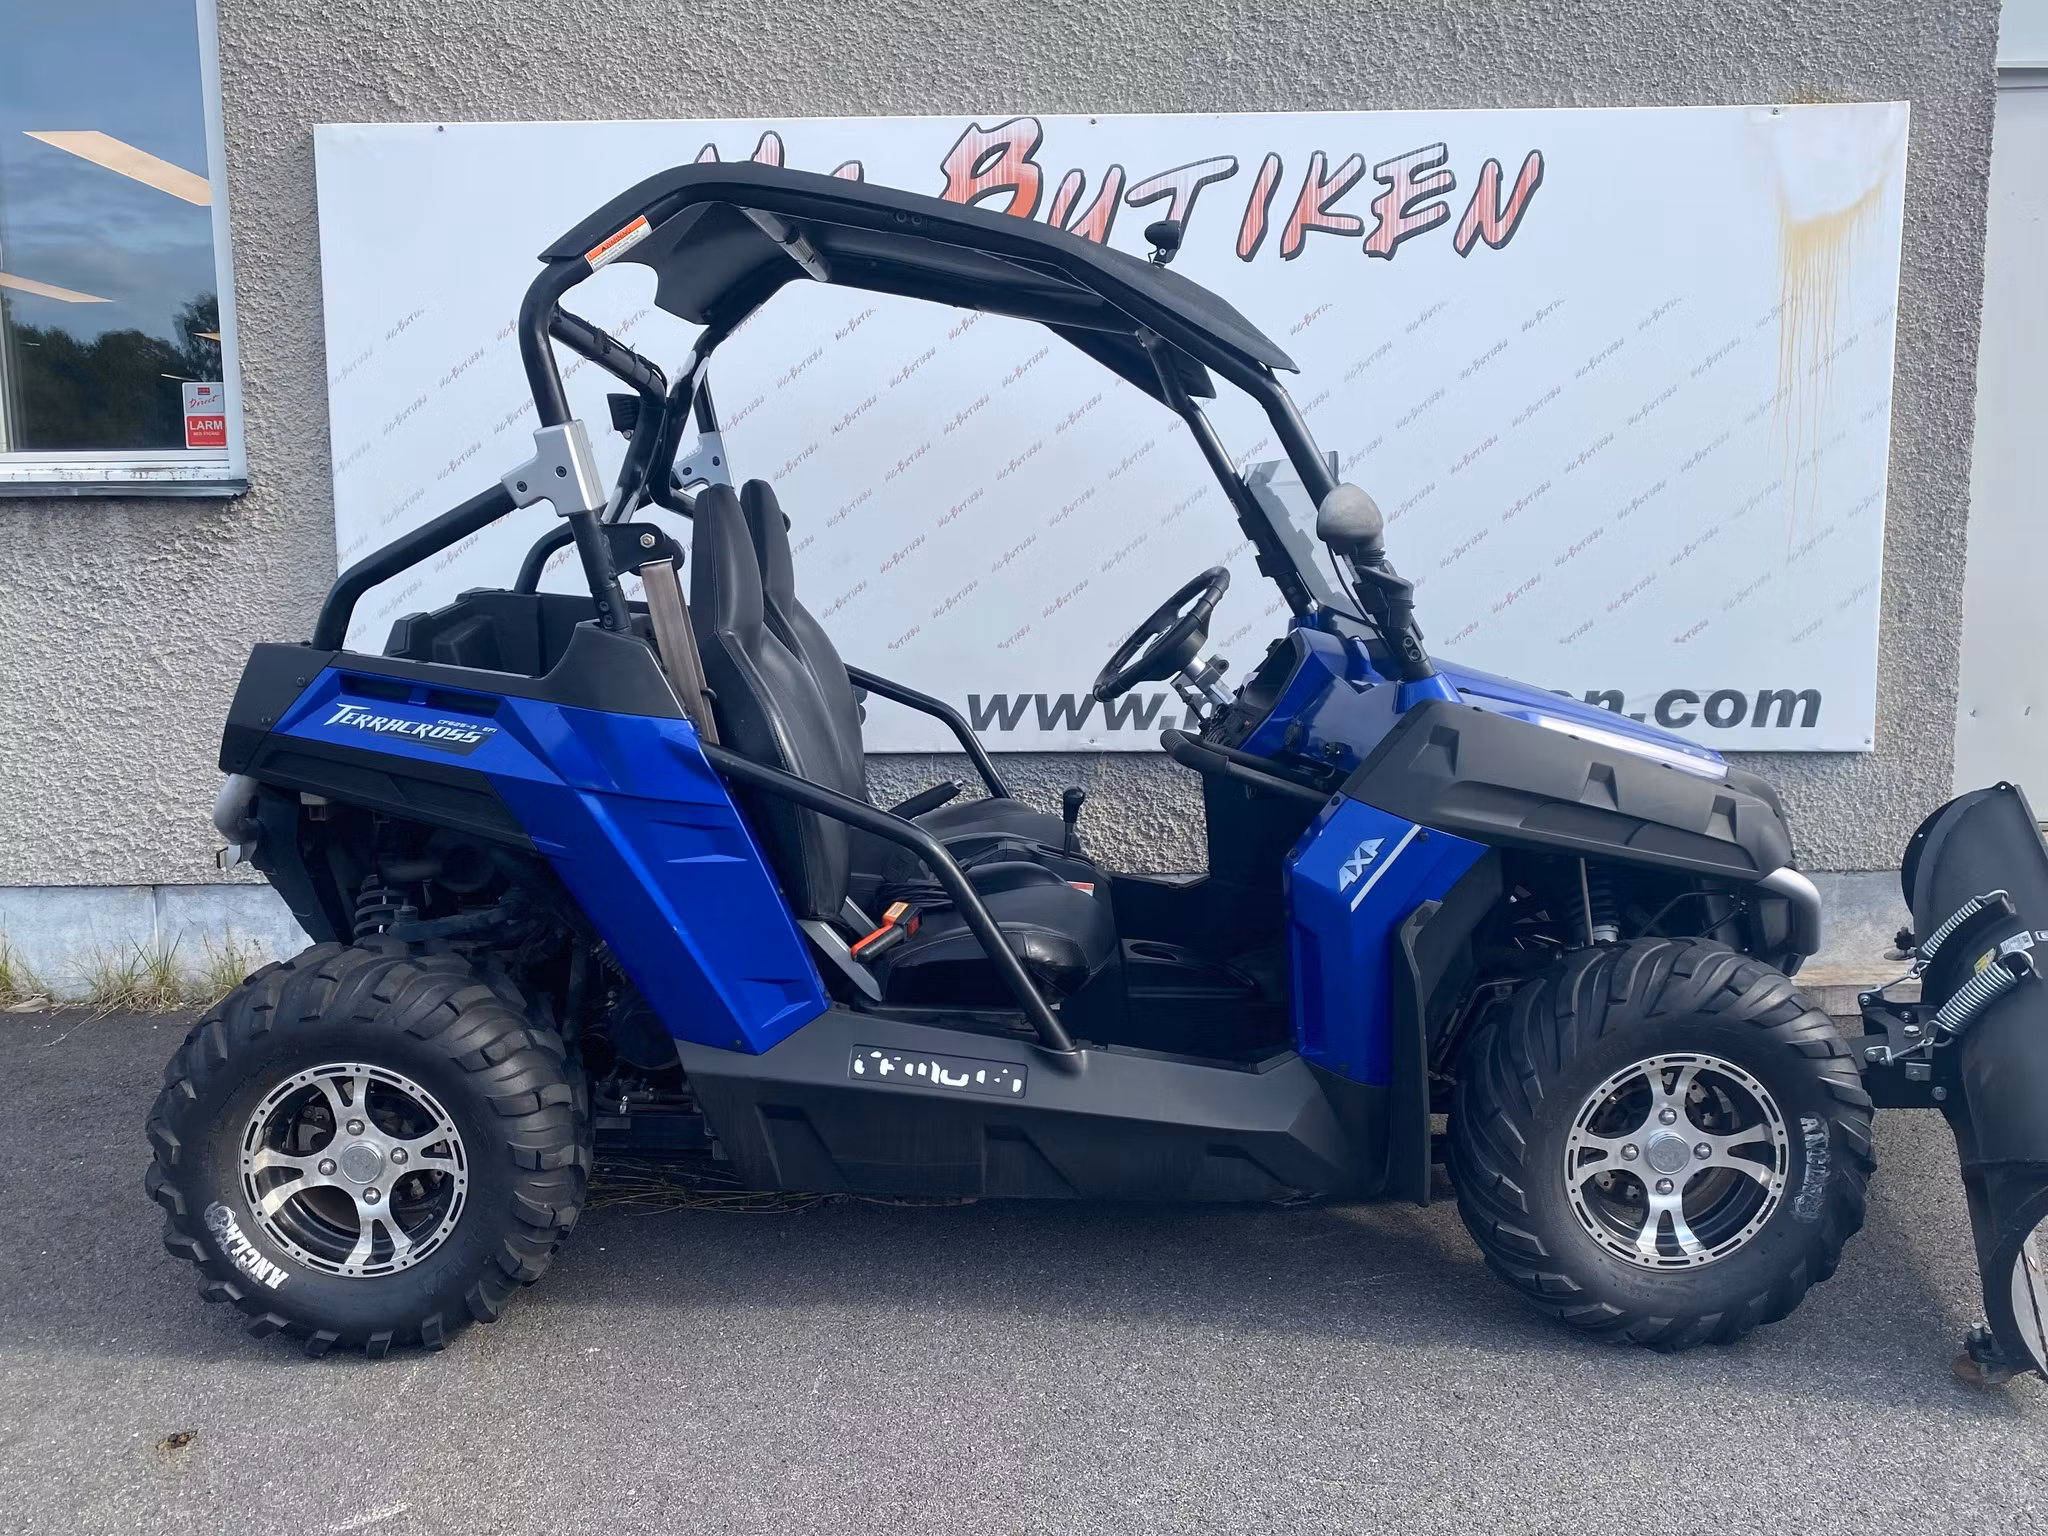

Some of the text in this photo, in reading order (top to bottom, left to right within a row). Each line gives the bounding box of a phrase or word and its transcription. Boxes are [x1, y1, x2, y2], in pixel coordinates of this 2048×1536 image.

[694, 116, 1545, 259] BUTIKEN
[190, 420, 223, 431] LARM
[323, 703, 484, 743] TERRACROSS
[213, 1222, 290, 1290] ANCLA
